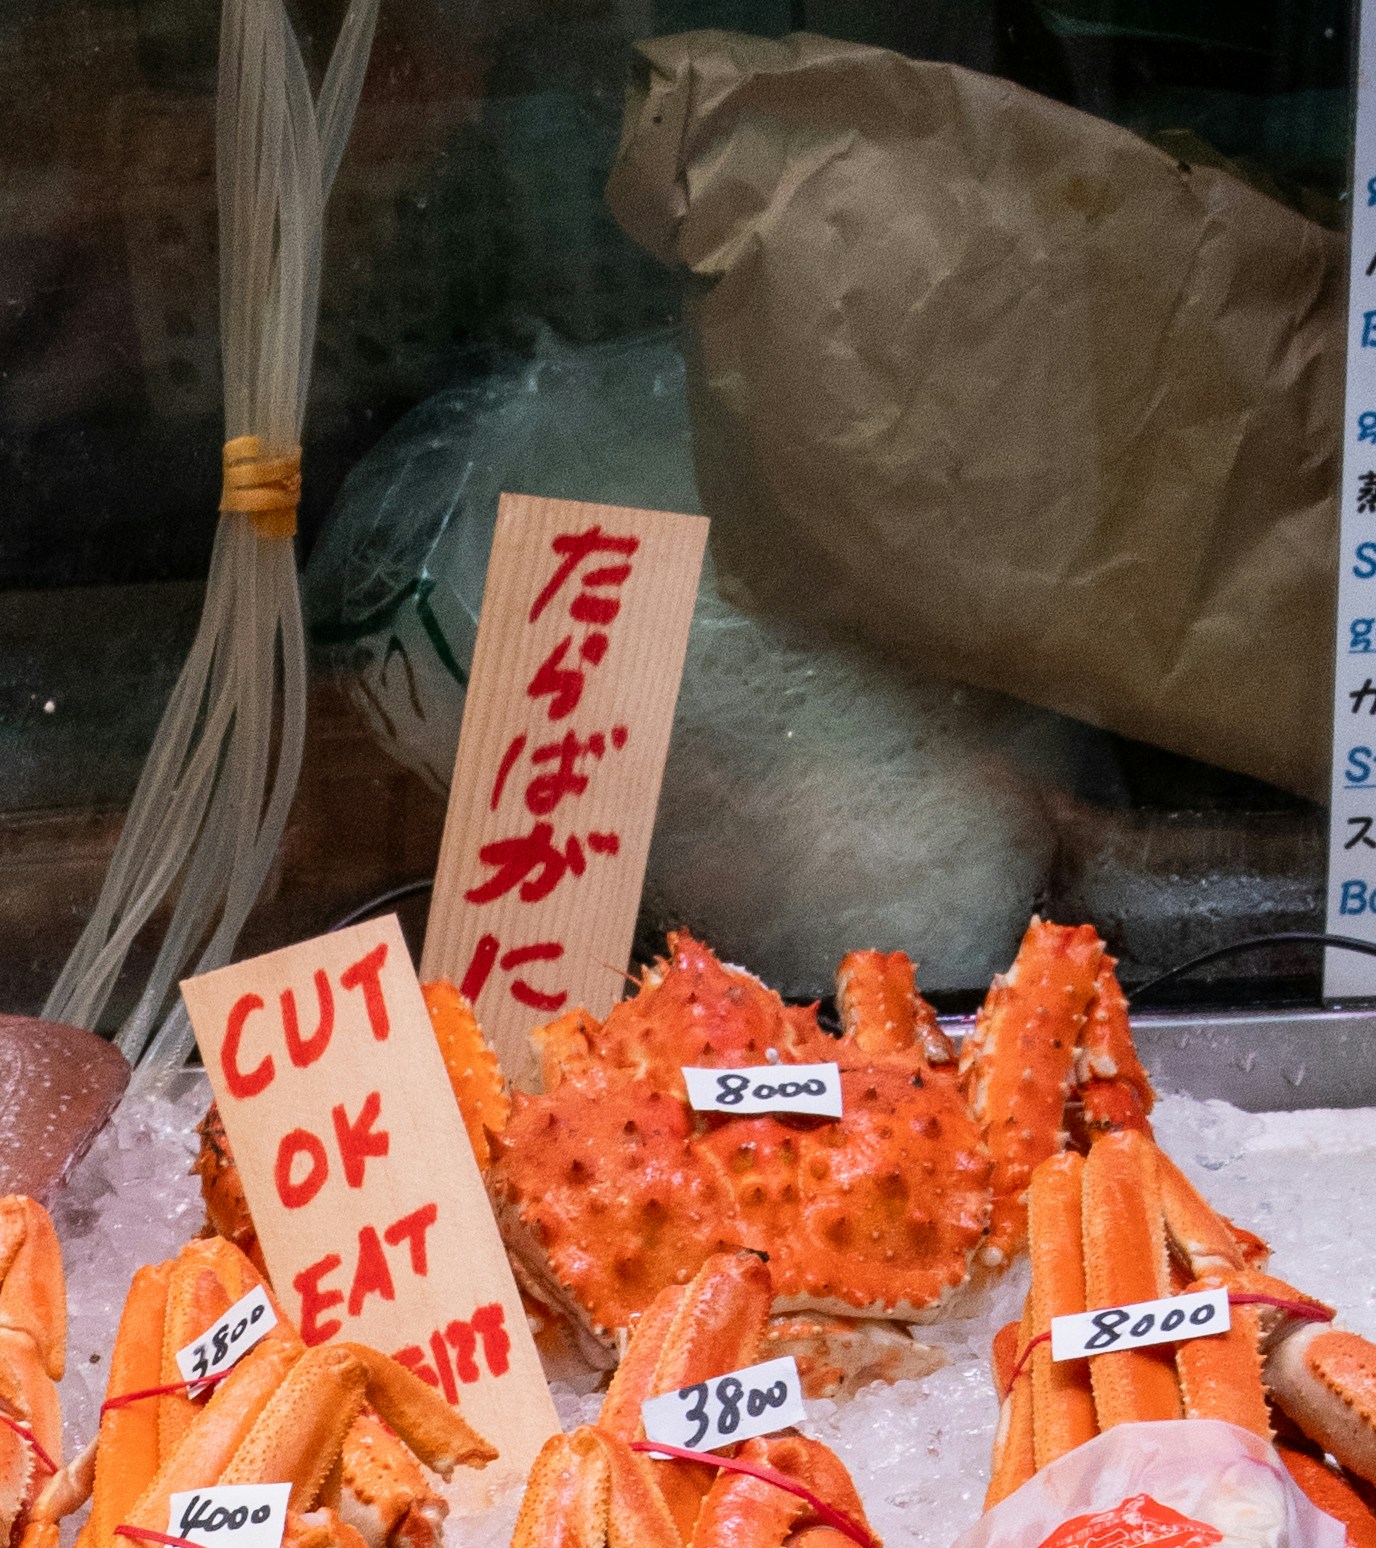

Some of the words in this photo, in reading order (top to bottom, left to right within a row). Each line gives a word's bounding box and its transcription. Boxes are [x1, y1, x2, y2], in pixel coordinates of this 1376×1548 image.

[461, 523, 643, 1015] たらばがに
[220, 943, 390, 1101] CUT
[714, 1072, 828, 1104] 8000
[274, 1091, 390, 1210] OK
[292, 1203, 438, 1349] EAT
[190, 1301, 267, 1381] 3800
[1084, 1301, 1216, 1351] 8000
[678, 1376, 789, 1450] 3800
[178, 1493, 272, 1535] 4000
